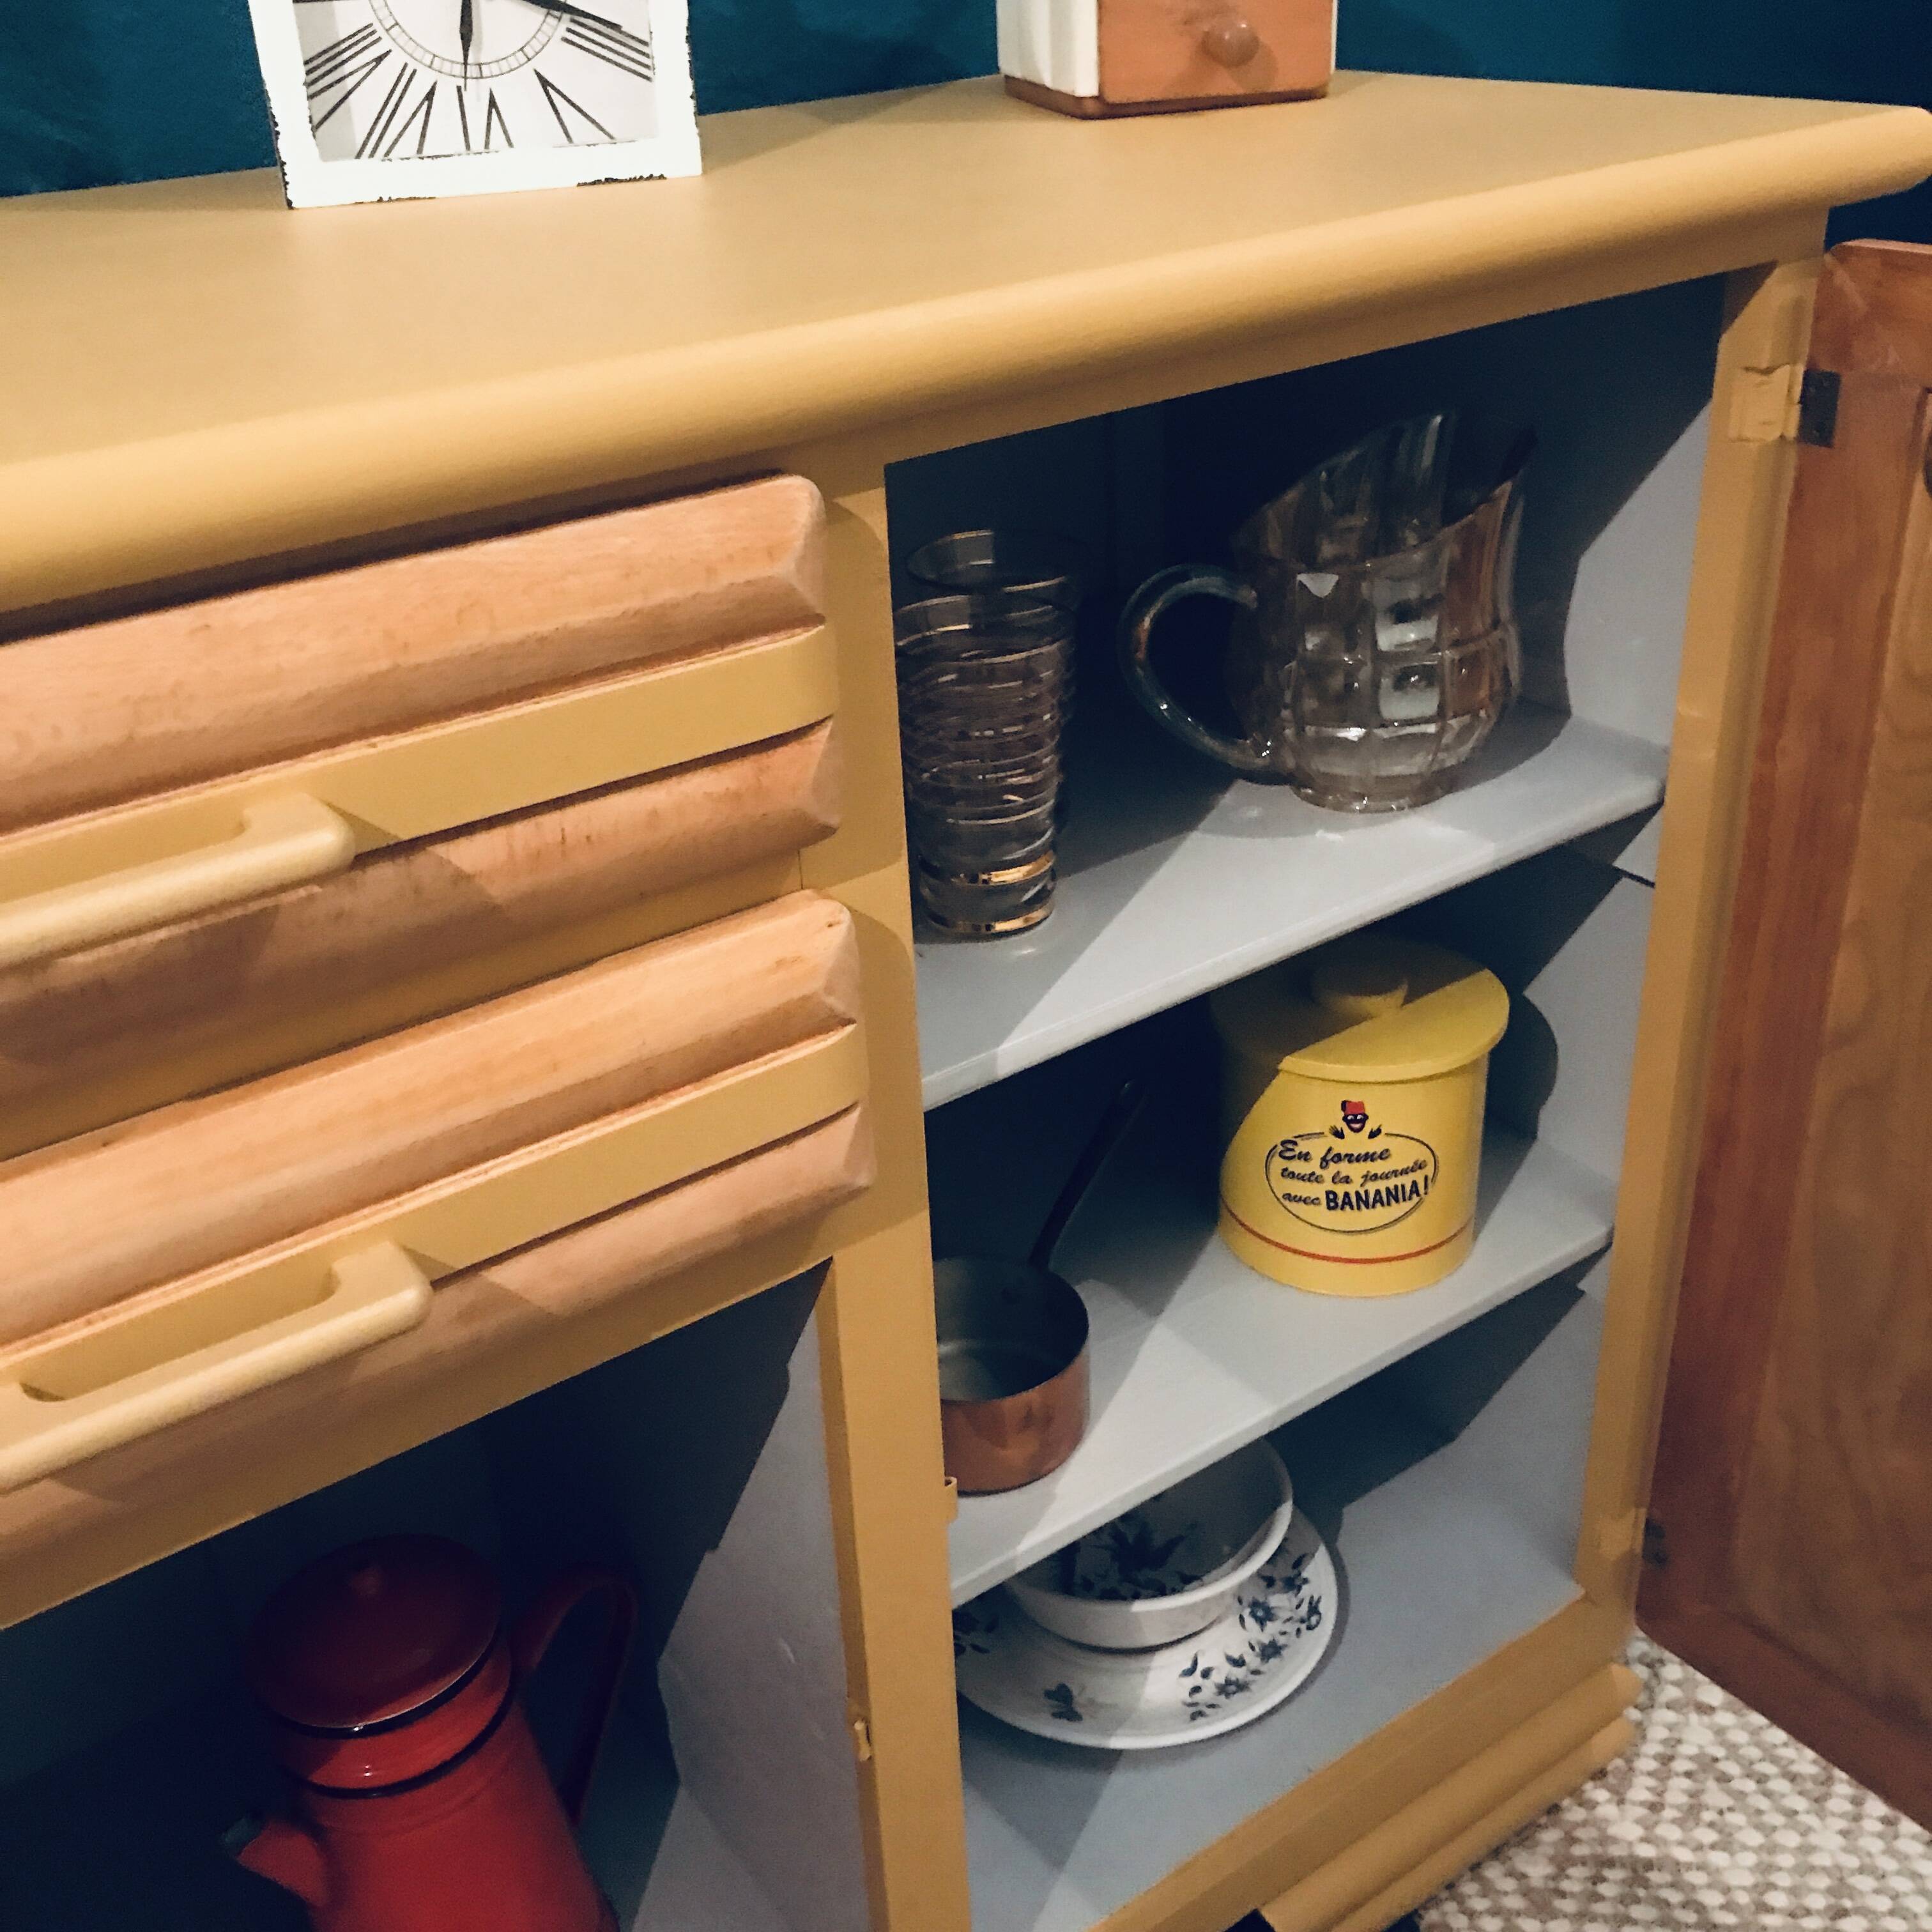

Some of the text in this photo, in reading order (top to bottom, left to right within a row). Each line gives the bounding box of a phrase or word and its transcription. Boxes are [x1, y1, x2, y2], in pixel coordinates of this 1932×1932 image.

[303, 22, 393, 133] VIII
[355, 62, 438, 160] VII
[533, 67, 616, 144] V
[457, 84, 514, 151] VI
[1278, 1139, 1391, 1169] En forme
[1281, 1160, 1428, 1187] toute la journée
[1282, 1175, 1429, 1211] avec BANANIA!
